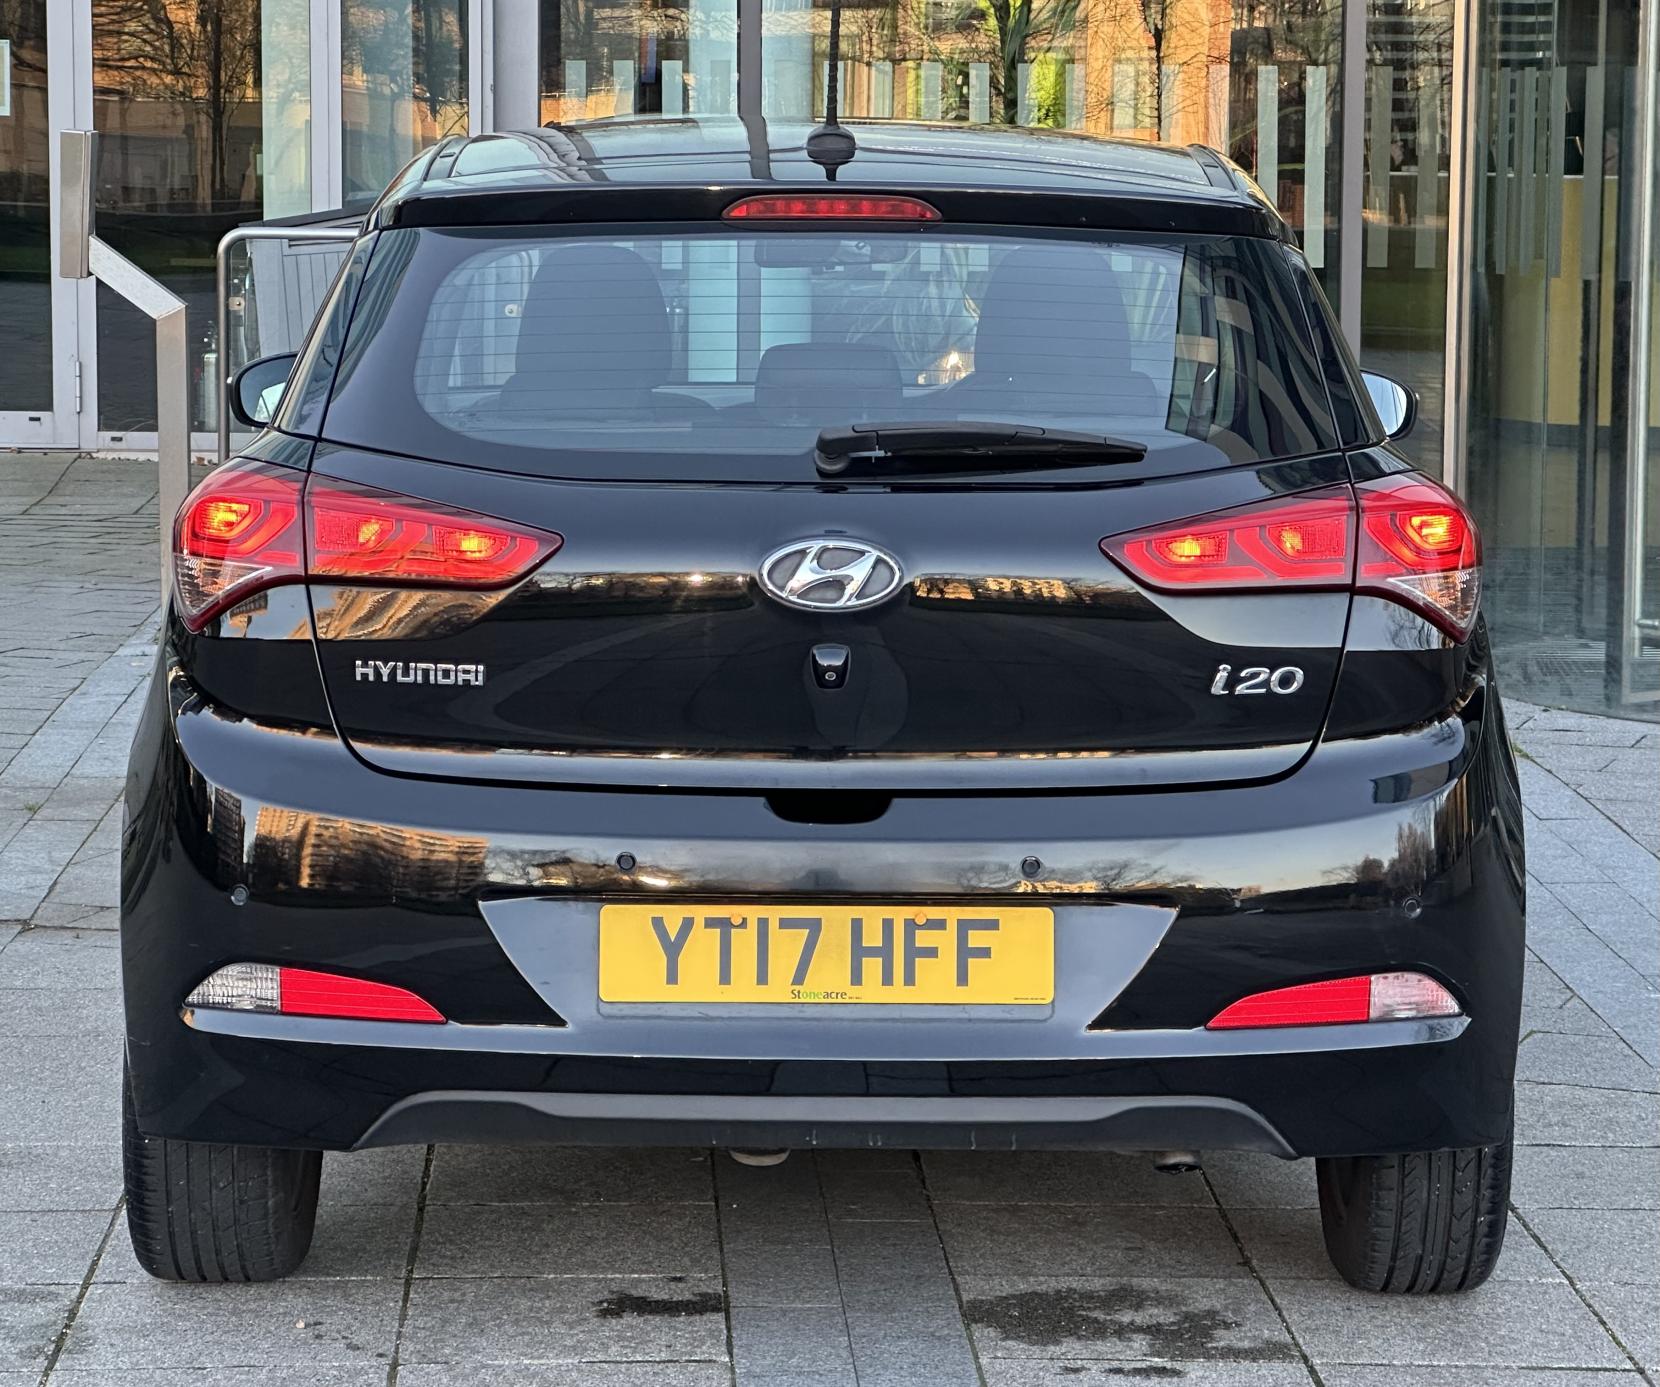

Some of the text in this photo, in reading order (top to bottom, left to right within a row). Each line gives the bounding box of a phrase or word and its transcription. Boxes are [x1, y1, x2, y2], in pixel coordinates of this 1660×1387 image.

[355, 660, 485, 686] HYUNDAI
[650, 916, 1000, 987] YT17 HFF
[791, 989, 848, 1000] Stoneacre
